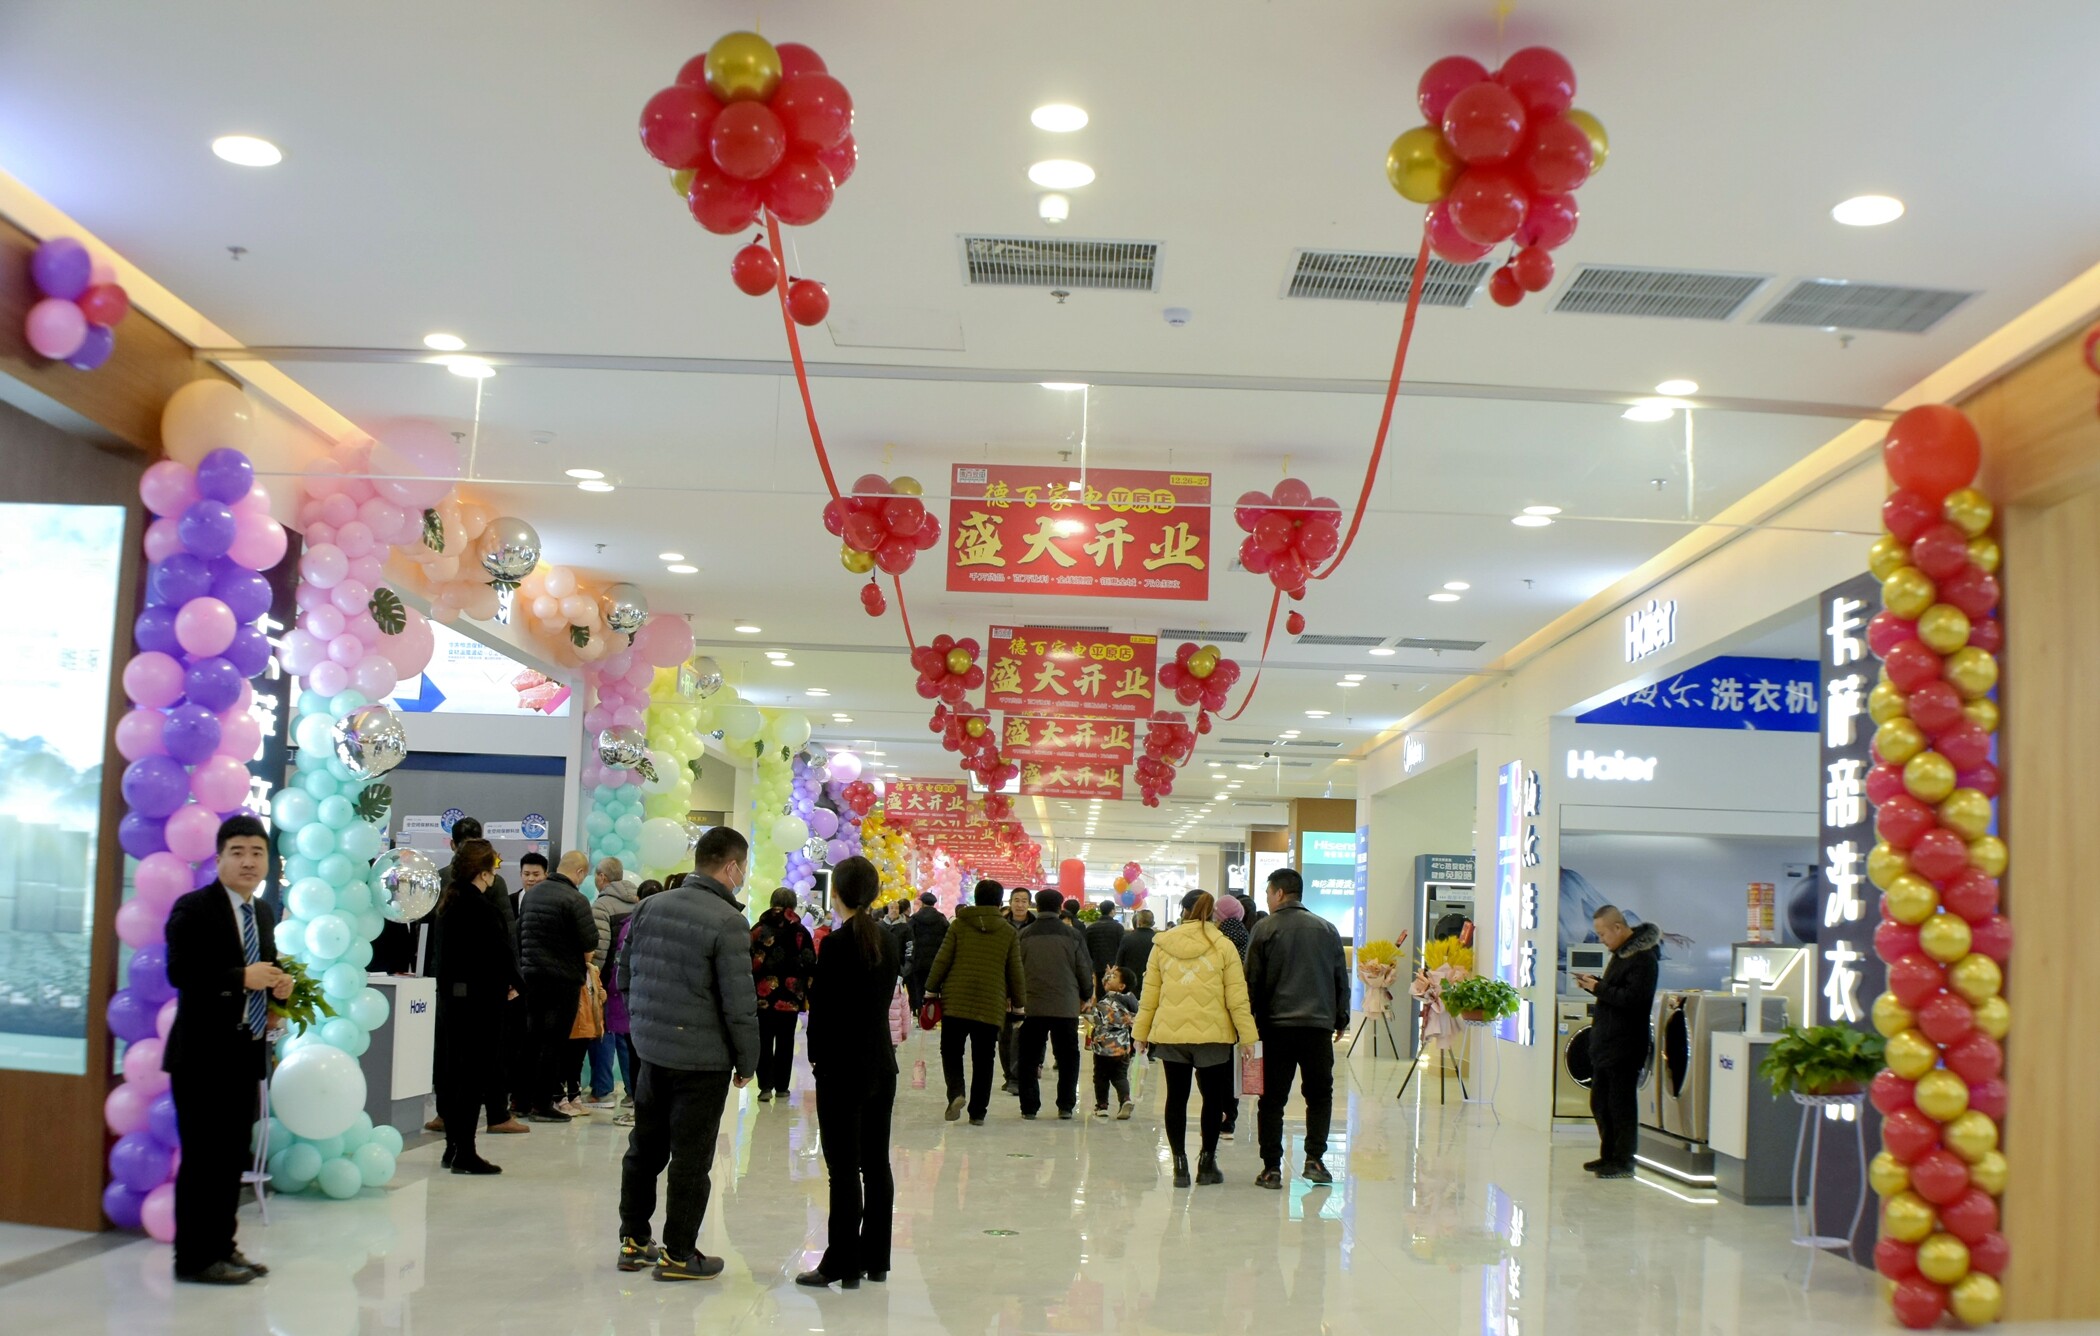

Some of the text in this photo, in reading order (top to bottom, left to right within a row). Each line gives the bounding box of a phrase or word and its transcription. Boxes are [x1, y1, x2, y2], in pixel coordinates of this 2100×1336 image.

[955, 511, 1205, 570] 盛大开业
[1625, 600, 1678, 664] Haier
[990, 657, 1152, 699] 盛大开业
[1005, 717, 1132, 750] 盛大开业
[1022, 763, 1121, 788] 盛大开业
[1567, 749, 1658, 781] Haier
[886, 791, 966, 812] 盛大开业
[1826, 597, 1867, 1121] 卡萨帝洗衣
[410, 999, 427, 1014] Haier
